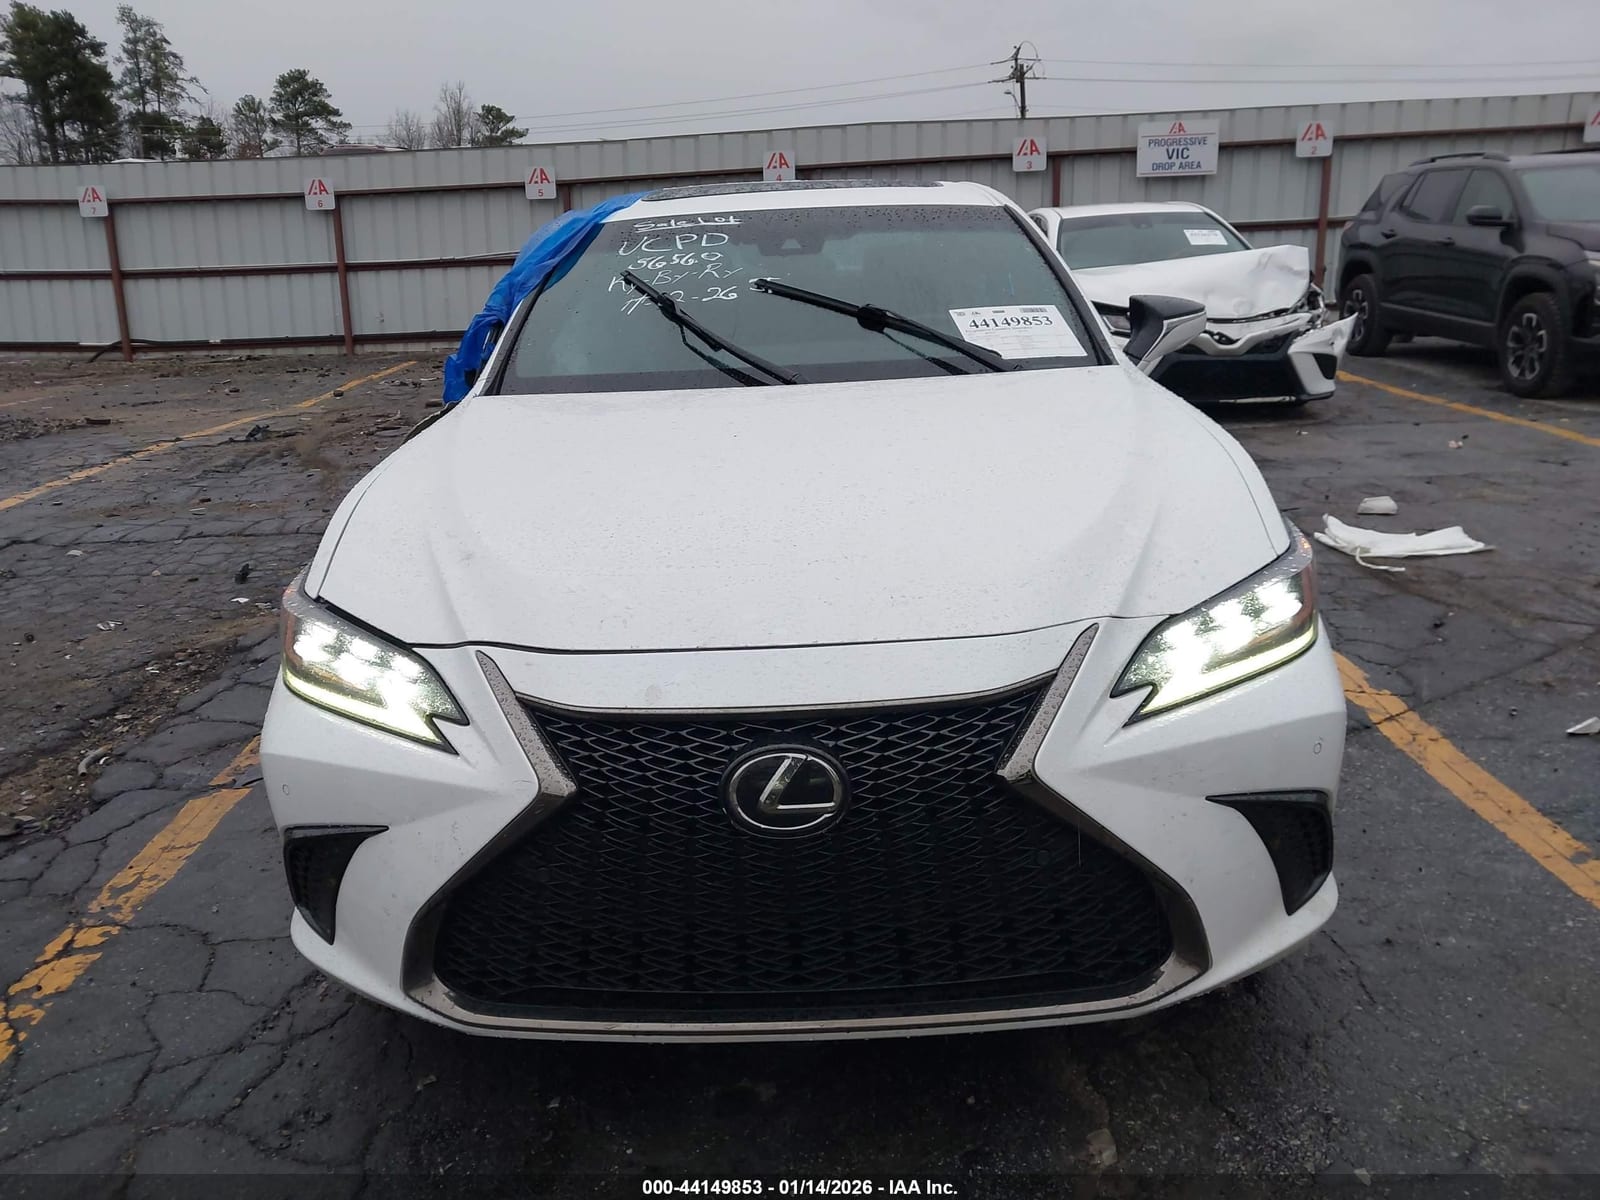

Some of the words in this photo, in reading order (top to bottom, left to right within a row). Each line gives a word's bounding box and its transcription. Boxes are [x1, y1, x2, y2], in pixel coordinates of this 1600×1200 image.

[1148, 136, 1208, 147] PROGRESSIVE
[1166, 147, 1190, 160] VIC
[1311, 146, 1317, 155] 2
[1026, 160, 1032, 169] 3
[1152, 162, 1176, 171] DROP
[1178, 160, 1202, 170] AREA
[538, 189, 544, 197] 5
[317, 200, 323, 208] 6
[91, 206, 97, 215] 7
[969, 315, 1053, 329] 44149853
